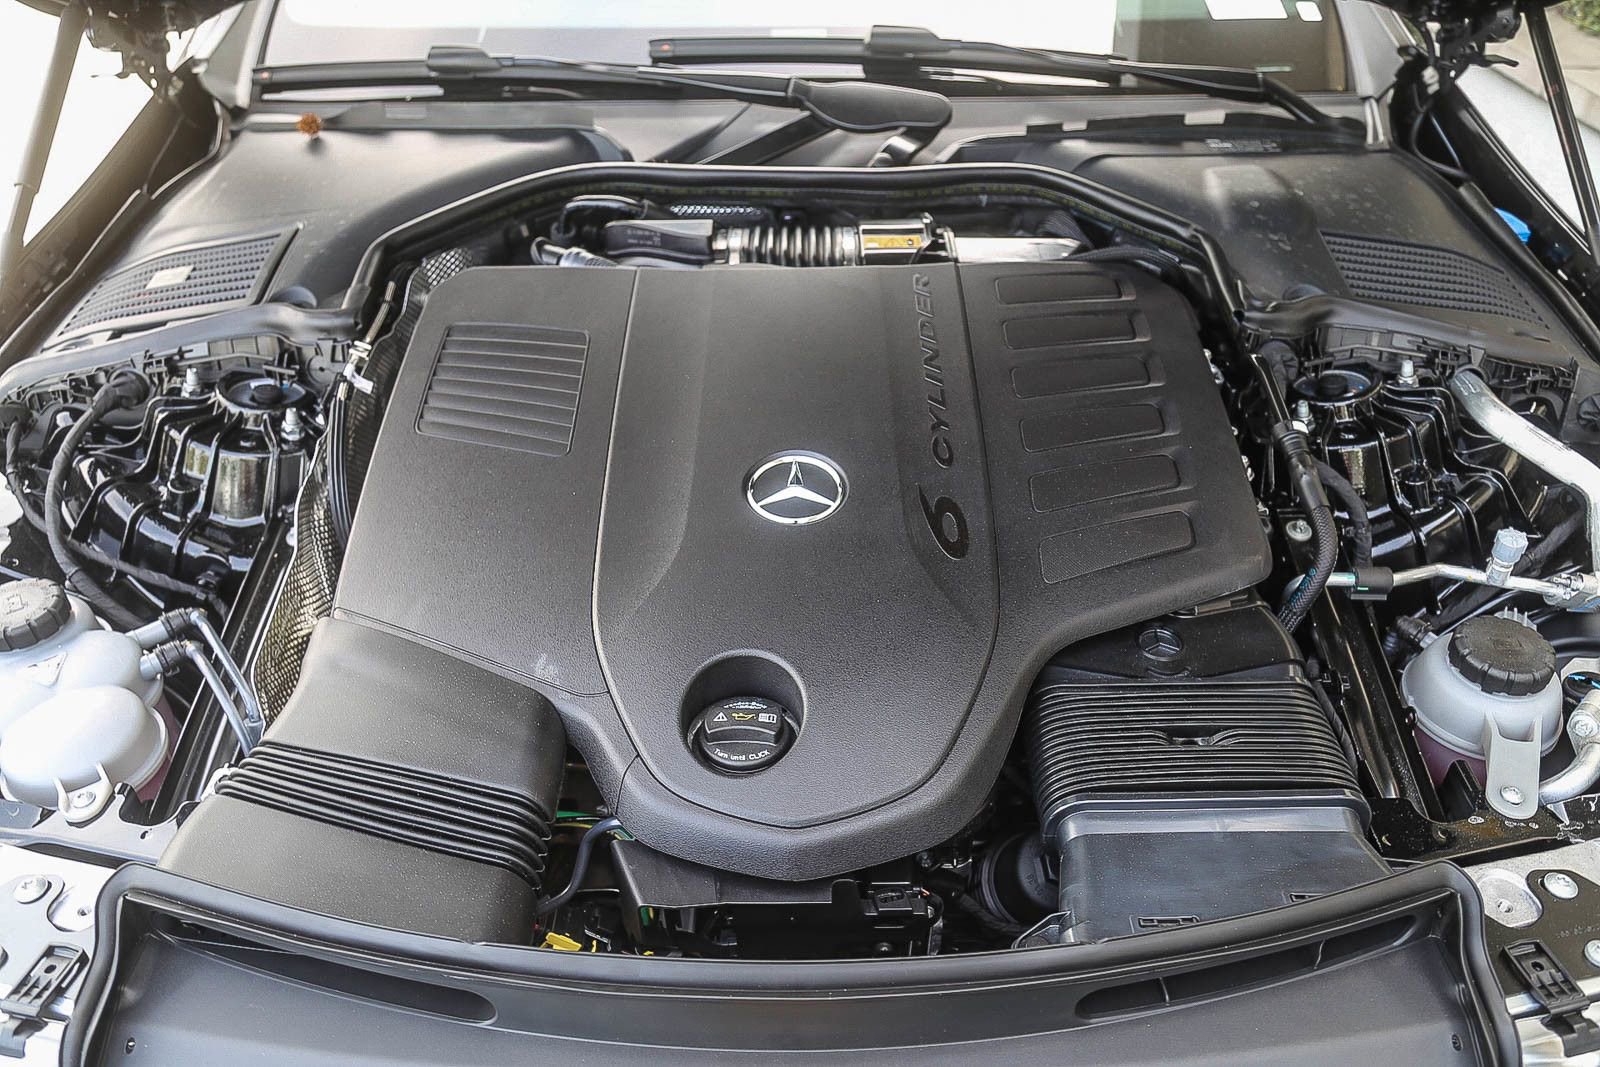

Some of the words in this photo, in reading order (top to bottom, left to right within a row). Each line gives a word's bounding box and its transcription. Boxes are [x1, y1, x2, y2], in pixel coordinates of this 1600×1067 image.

[913, 273, 954, 468] CYLINDER
[914, 483, 969, 560] 6
[713, 748, 728, 759] Turn
[730, 753, 746, 761] until
[748, 749, 771, 760] CLICK
